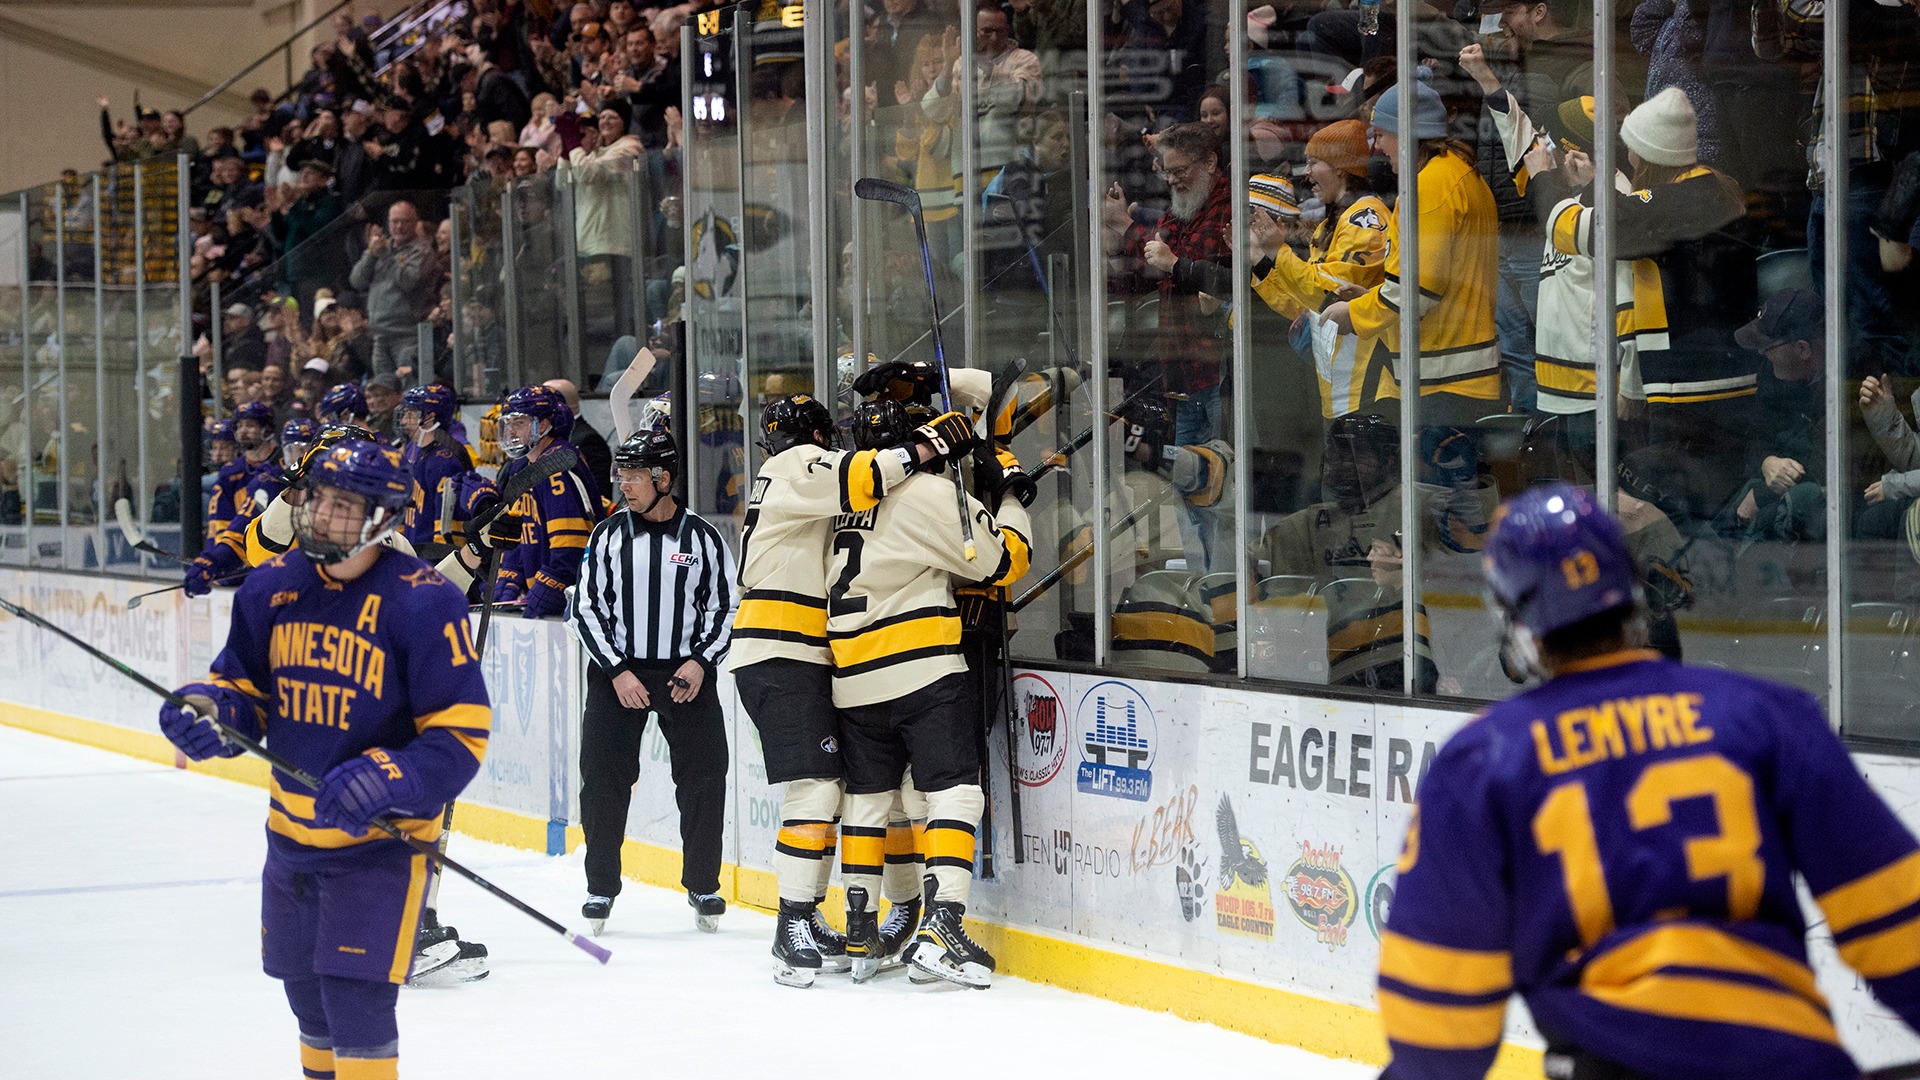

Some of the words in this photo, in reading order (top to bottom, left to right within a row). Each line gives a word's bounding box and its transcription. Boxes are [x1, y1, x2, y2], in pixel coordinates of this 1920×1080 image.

[768, 421, 779, 433] 77
[871, 415, 879, 425] 2
[550, 472, 566, 496] 5
[976, 509, 1001, 538] 2
[670, 553, 699, 567] CCHA
[830, 531, 868, 618] 2
[1560, 549, 1600, 592] 13
[356, 594, 382, 634] A
[277, 676, 357, 731] STATE
[1028, 695, 1057, 733] WOLF
[1531, 693, 1715, 776] LEMYRE
[1030, 763, 1052, 781] CLASSIC
[1249, 721, 1373, 799] EAGLE
[1081, 767, 1093, 778] The
[1092, 767, 1116, 792] LIFT
[1115, 777, 1135, 795] 99.3
[1135, 780, 1148, 797] FM
[1129, 784, 1198, 878] K-BEAR
[1006, 833, 1051, 866] LTEN
[1054, 829, 1072, 876] UP
[1075, 843, 1121, 879] RADIO
[1301, 839, 1344, 873] Rockin'
[1531, 753, 1766, 948] 13
[1216, 894, 1240, 915] WCUP
[1241, 899, 1264, 920] 105.7
[1264, 907, 1274, 921] FM
[1301, 884, 1320, 899] 98.7
[1321, 888, 1335, 901] FM
[936, 922, 970, 957] CCM
[1217, 913, 1240, 931] EAGLE
[1241, 917, 1274, 937] COUNTRY
[1317, 914, 1347, 952] Eagle
